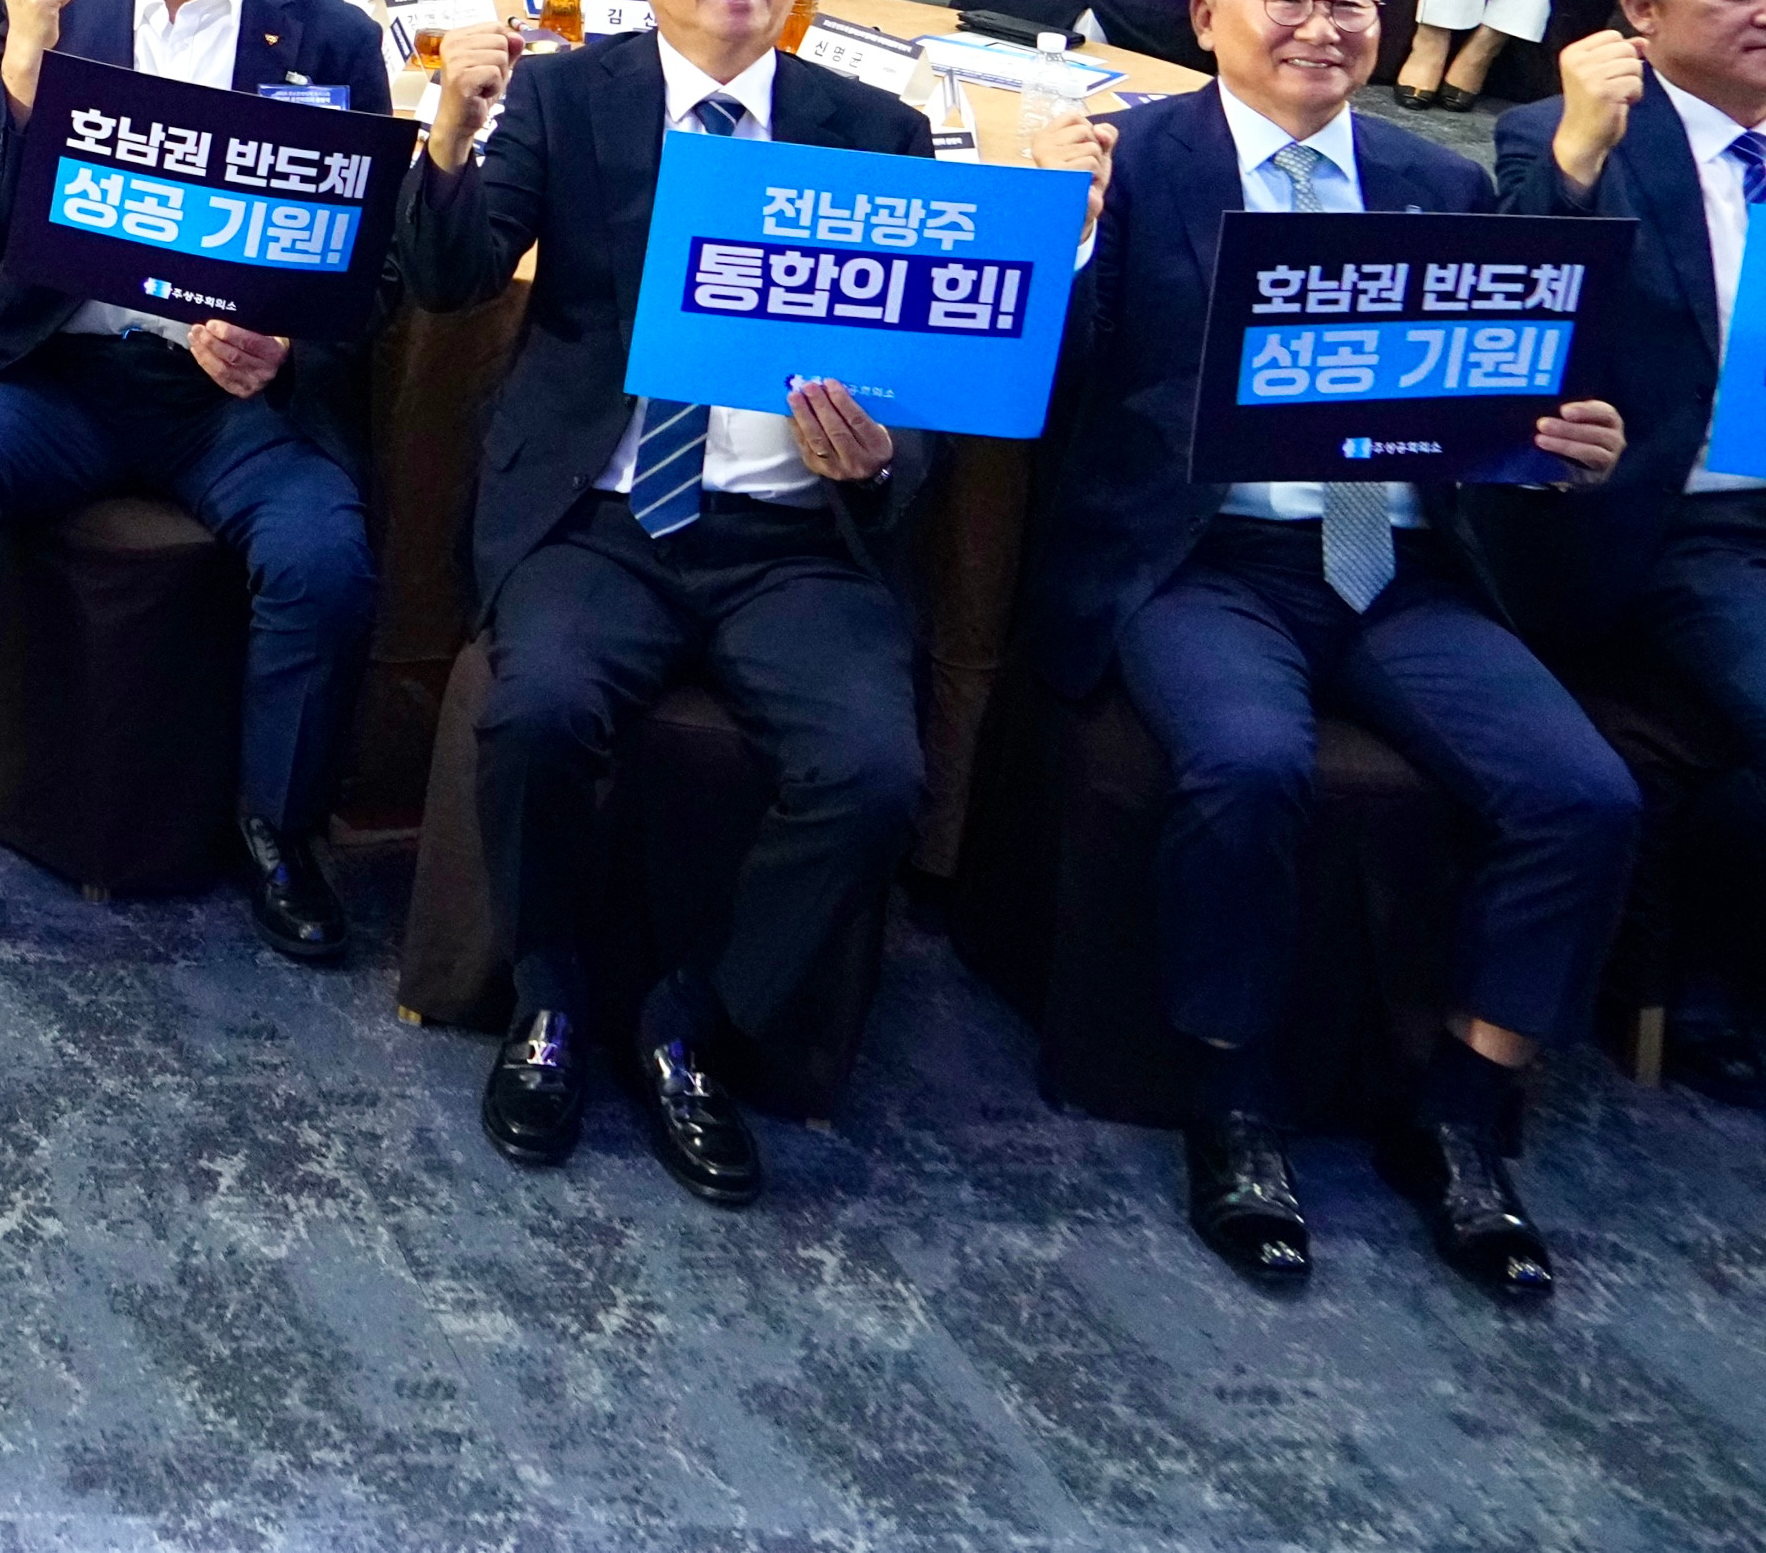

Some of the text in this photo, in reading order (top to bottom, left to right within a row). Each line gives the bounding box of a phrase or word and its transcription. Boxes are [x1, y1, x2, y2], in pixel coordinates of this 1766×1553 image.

[66, 109, 371, 198] 호남권 반도체
[64, 168, 348, 263] 성공 기원!
[763, 187, 976, 250] 전남광주
[158, 279, 237, 311] 주상공회의소
[695, 244, 1020, 329] 통합의 힘!
[1252, 263, 1584, 313] 호남권 반도체
[1253, 327, 1559, 395] 성공 기원!
[1356, 438, 1443, 458] 주상공회의소
